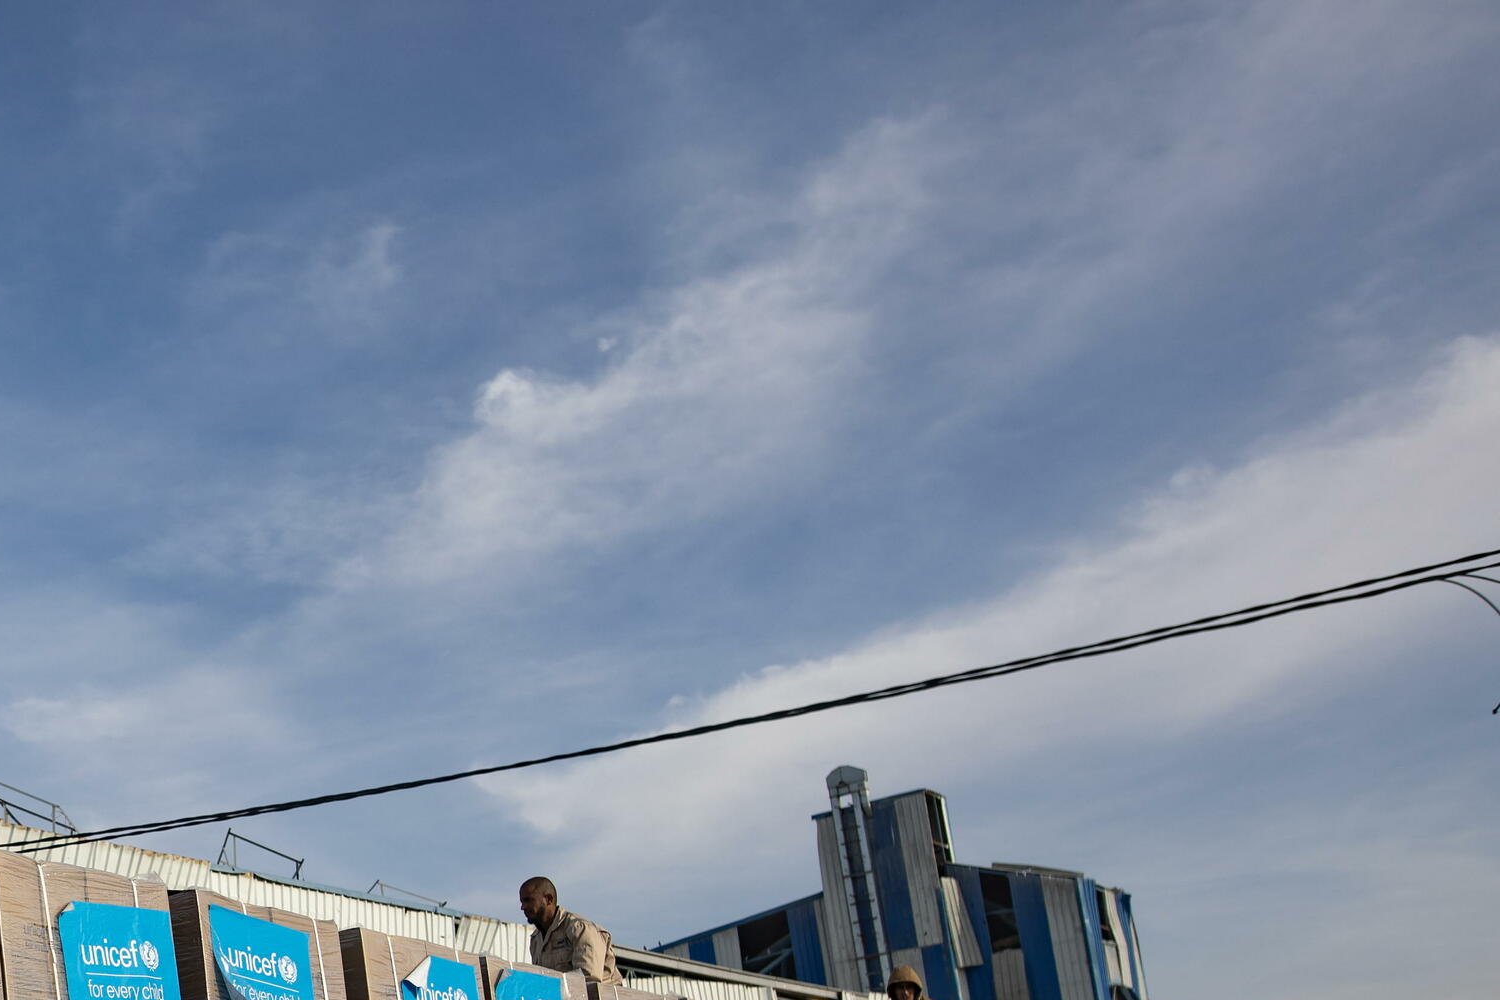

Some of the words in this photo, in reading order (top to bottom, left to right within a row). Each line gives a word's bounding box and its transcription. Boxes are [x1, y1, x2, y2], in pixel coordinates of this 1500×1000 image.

[80, 938, 138, 967] unicef
[227, 945, 277, 978] unicef
[88, 978, 104, 998] for
